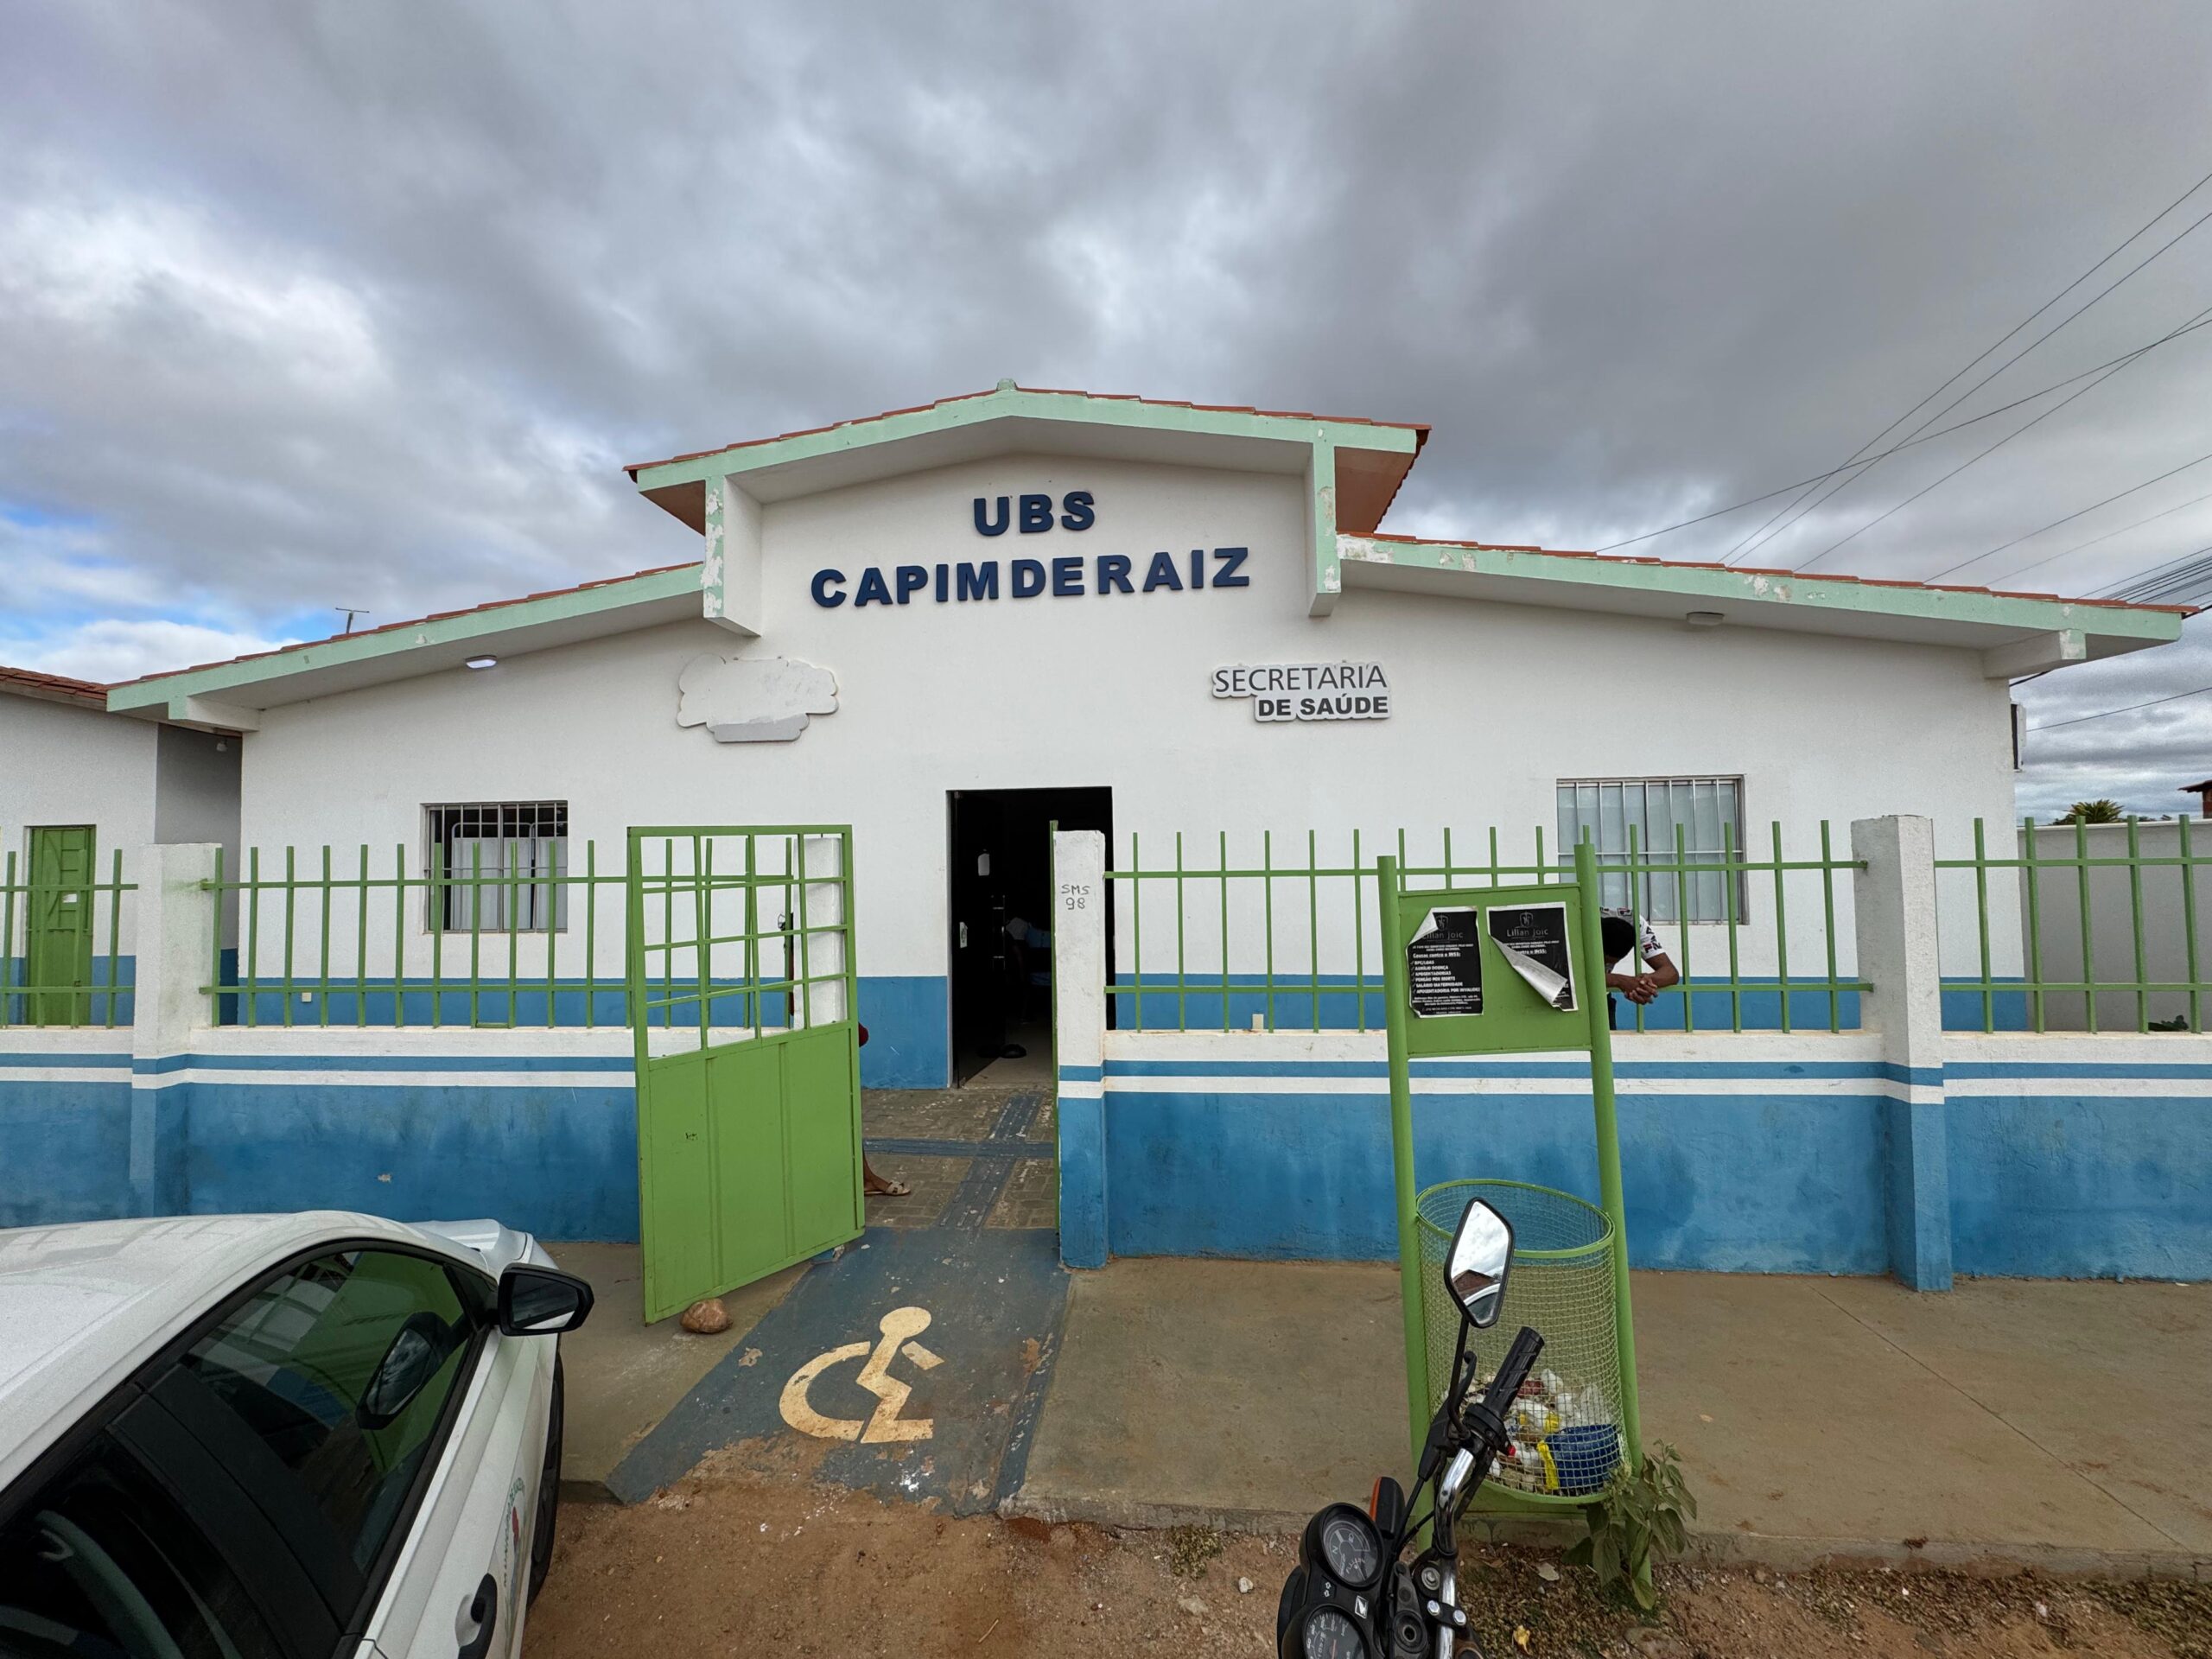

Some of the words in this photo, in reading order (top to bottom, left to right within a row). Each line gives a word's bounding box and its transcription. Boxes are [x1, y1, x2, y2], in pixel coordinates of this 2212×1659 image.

[974, 490, 1096, 536] UBS
[1215, 665, 1387, 692] SECRETARIA
[1259, 698, 1291, 716] DE
[1300, 693, 1389, 715] SAÚDE
[1061, 884, 1090, 895] SMS
[1065, 897, 1085, 910] 98
